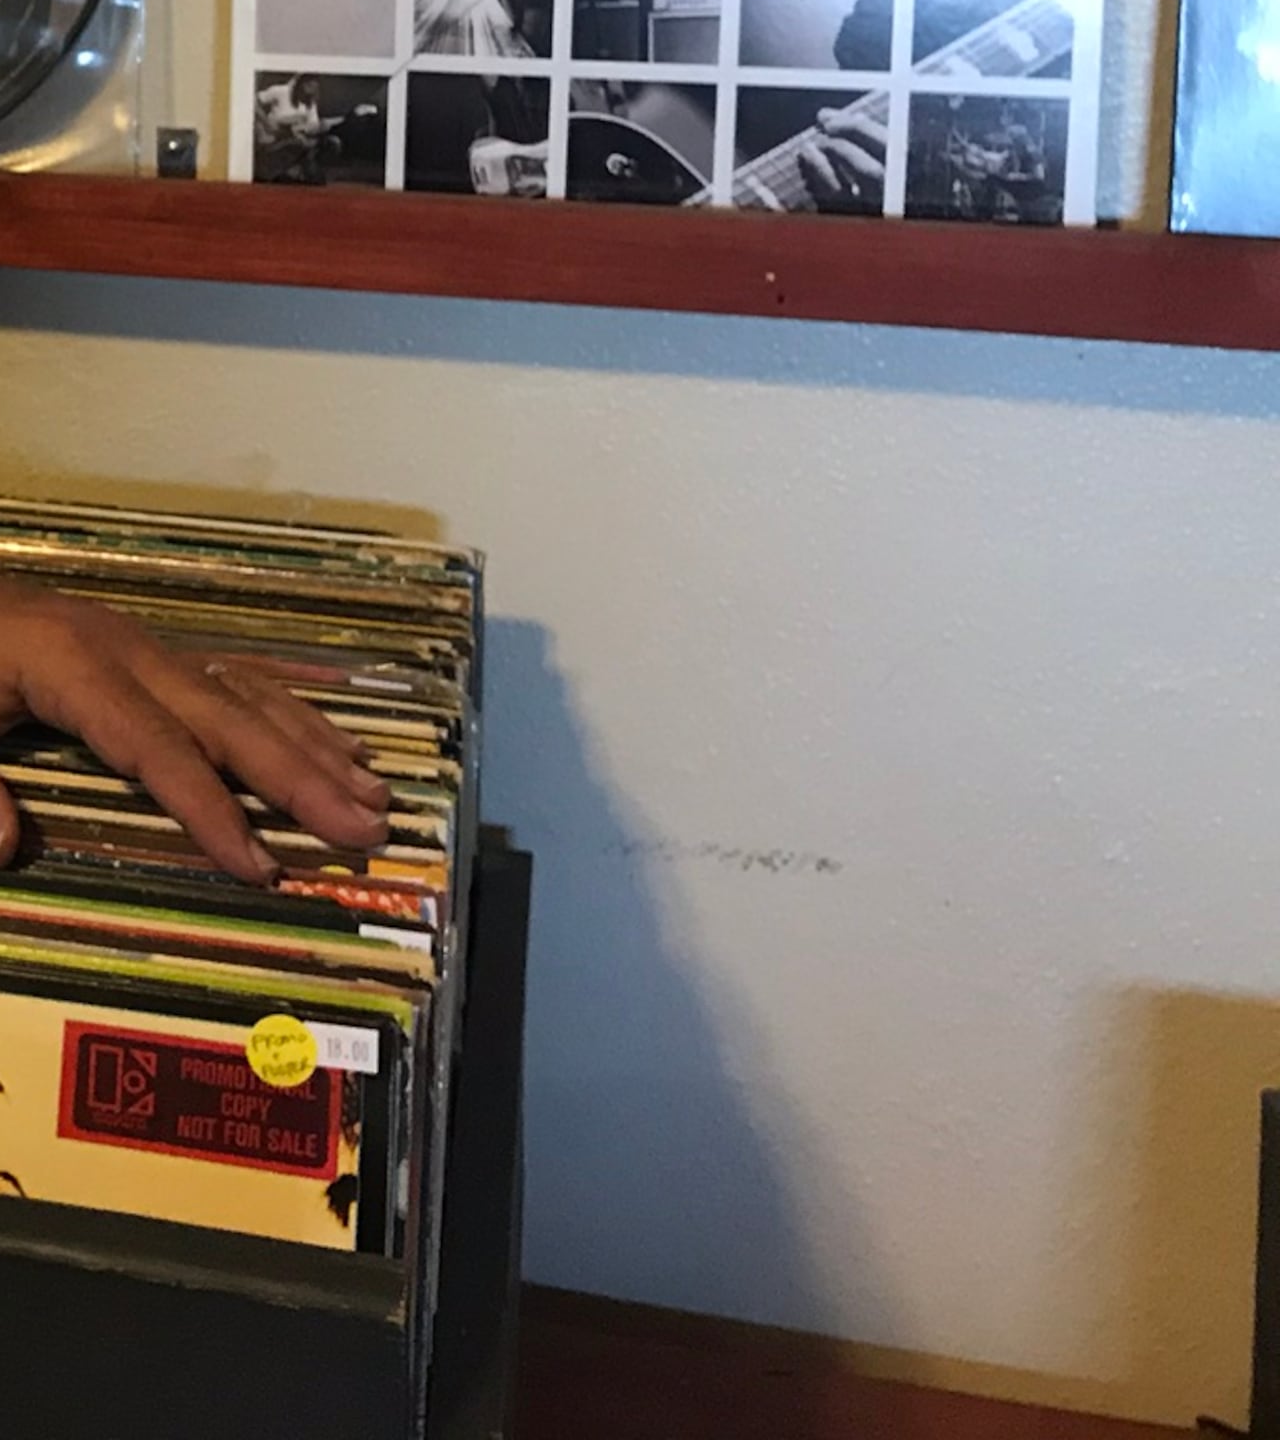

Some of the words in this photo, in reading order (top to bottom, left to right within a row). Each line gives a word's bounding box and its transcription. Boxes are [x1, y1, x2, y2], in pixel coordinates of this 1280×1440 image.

[220, 1092, 273, 1122] COPY
[176, 1116, 216, 1141] NOT
[224, 1120, 261, 1148] FOR
[267, 1128, 318, 1158] SALE
